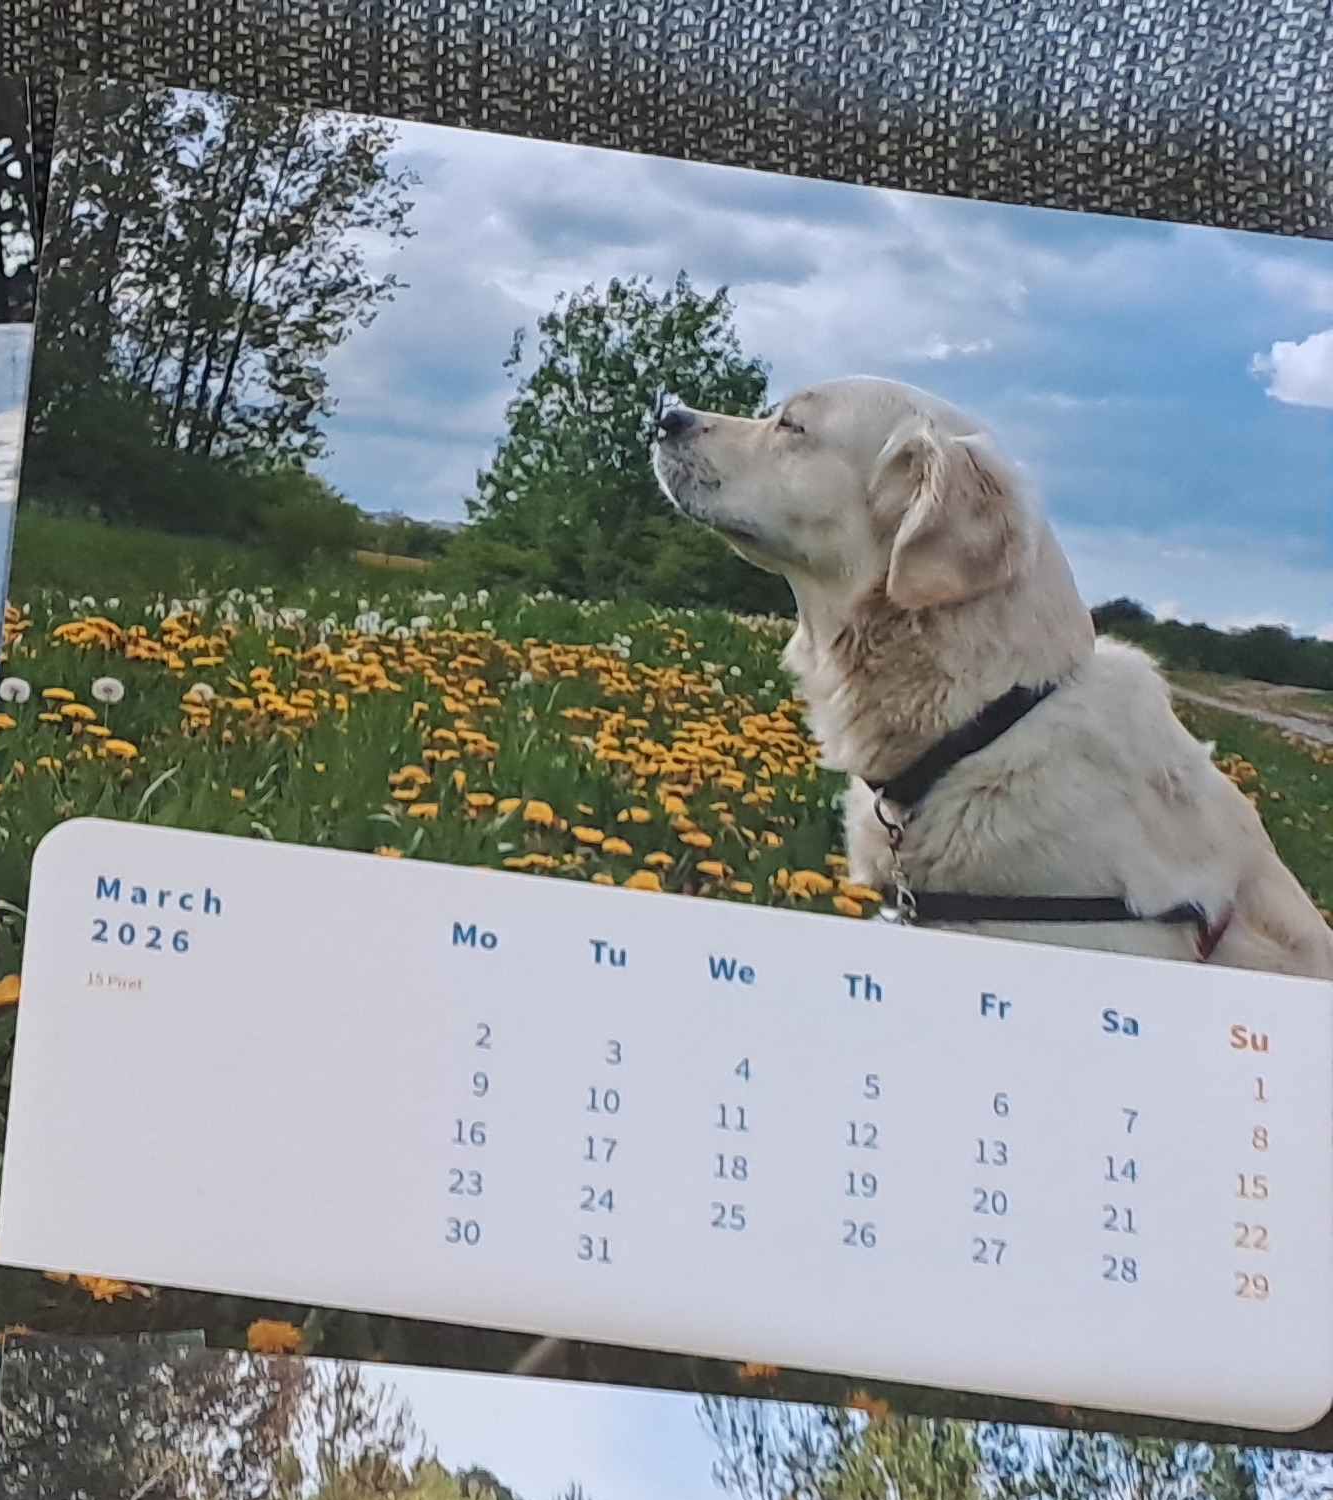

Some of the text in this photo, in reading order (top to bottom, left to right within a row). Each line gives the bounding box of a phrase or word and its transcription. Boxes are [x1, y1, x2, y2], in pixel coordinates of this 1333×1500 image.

[92, 919, 188, 952] 2026
[95, 876, 222, 916] March
[453, 922, 1268, 1052] Mo Tu We Th Fr Sa Su
[585, 1086, 1269, 1200] 10 11 12 13 14 15
[1251, 1126, 1269, 1151] 8
[452, 1118, 1268, 1251] 16 17 18 19 20 21 22
[445, 1217, 611, 1264] 30 31
[449, 1167, 1270, 1299] 23 24 25 26 27 28 29
